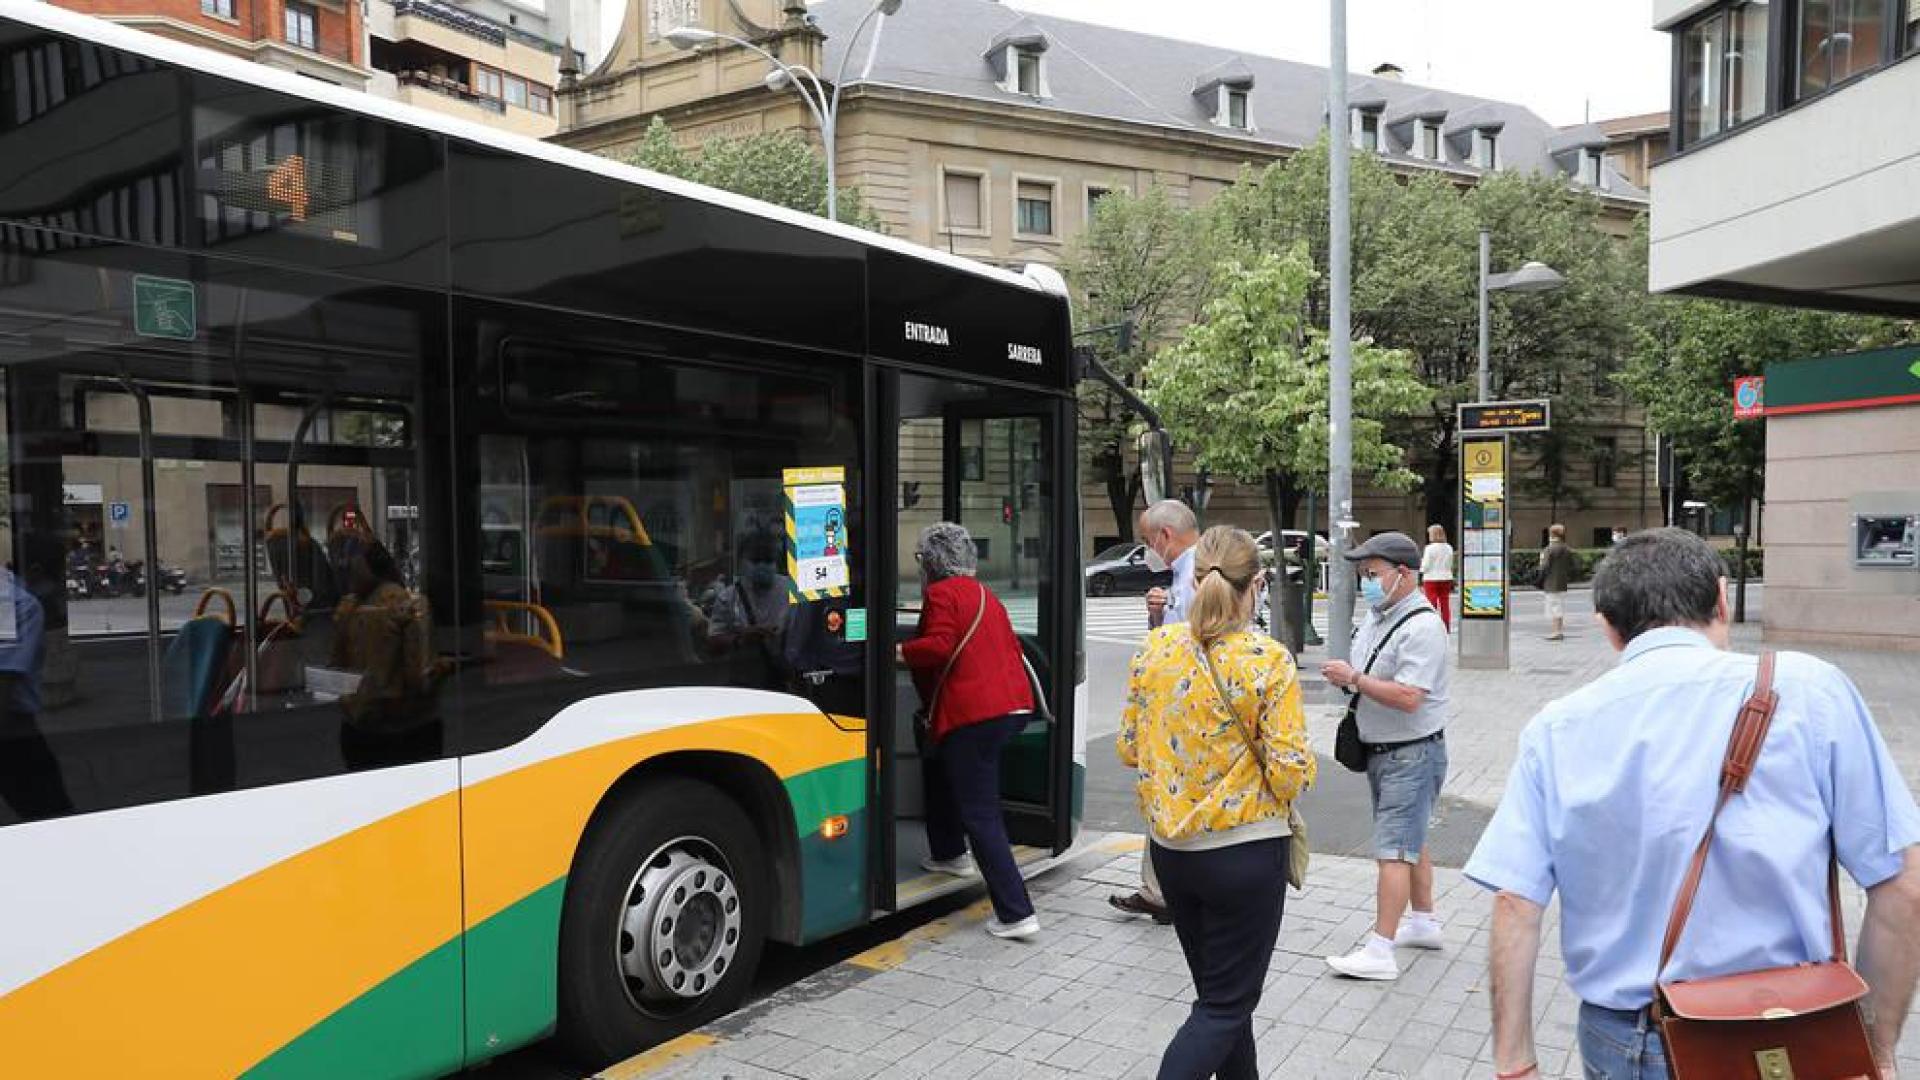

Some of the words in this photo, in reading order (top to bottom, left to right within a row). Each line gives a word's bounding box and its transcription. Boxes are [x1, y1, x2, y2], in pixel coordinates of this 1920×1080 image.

[267, 154, 309, 221] 4
[905, 321, 949, 346] ENTRADA
[1008, 342, 1042, 366] SARRERA
[815, 566, 827, 581] 54
